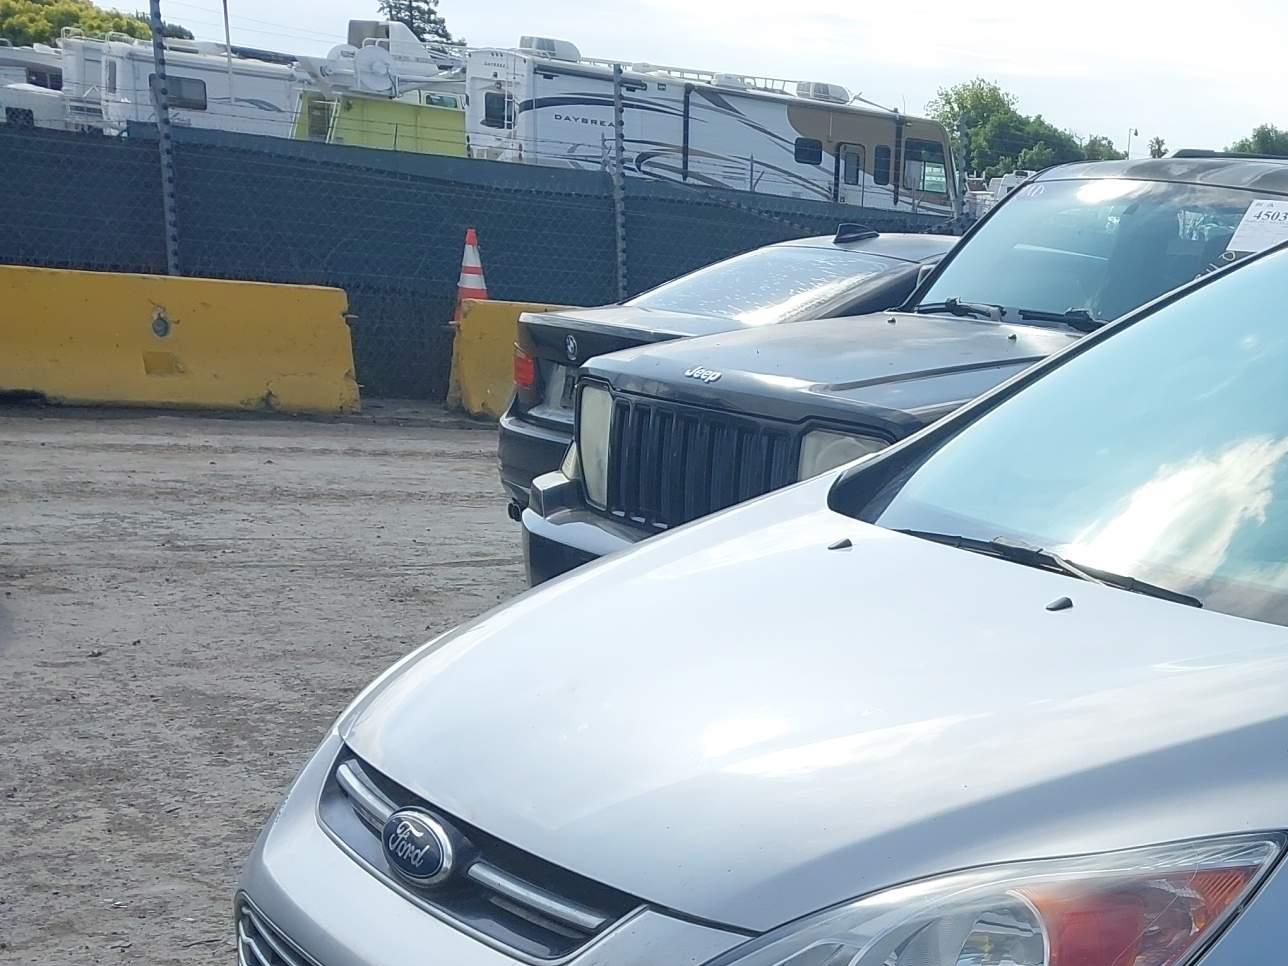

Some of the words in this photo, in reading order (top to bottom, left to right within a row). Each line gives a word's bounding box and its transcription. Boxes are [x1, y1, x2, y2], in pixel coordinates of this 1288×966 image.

[554, 114, 622, 128] DAYBREA
[684, 366, 721, 383] Jeep
[388, 820, 431, 868] Ford
